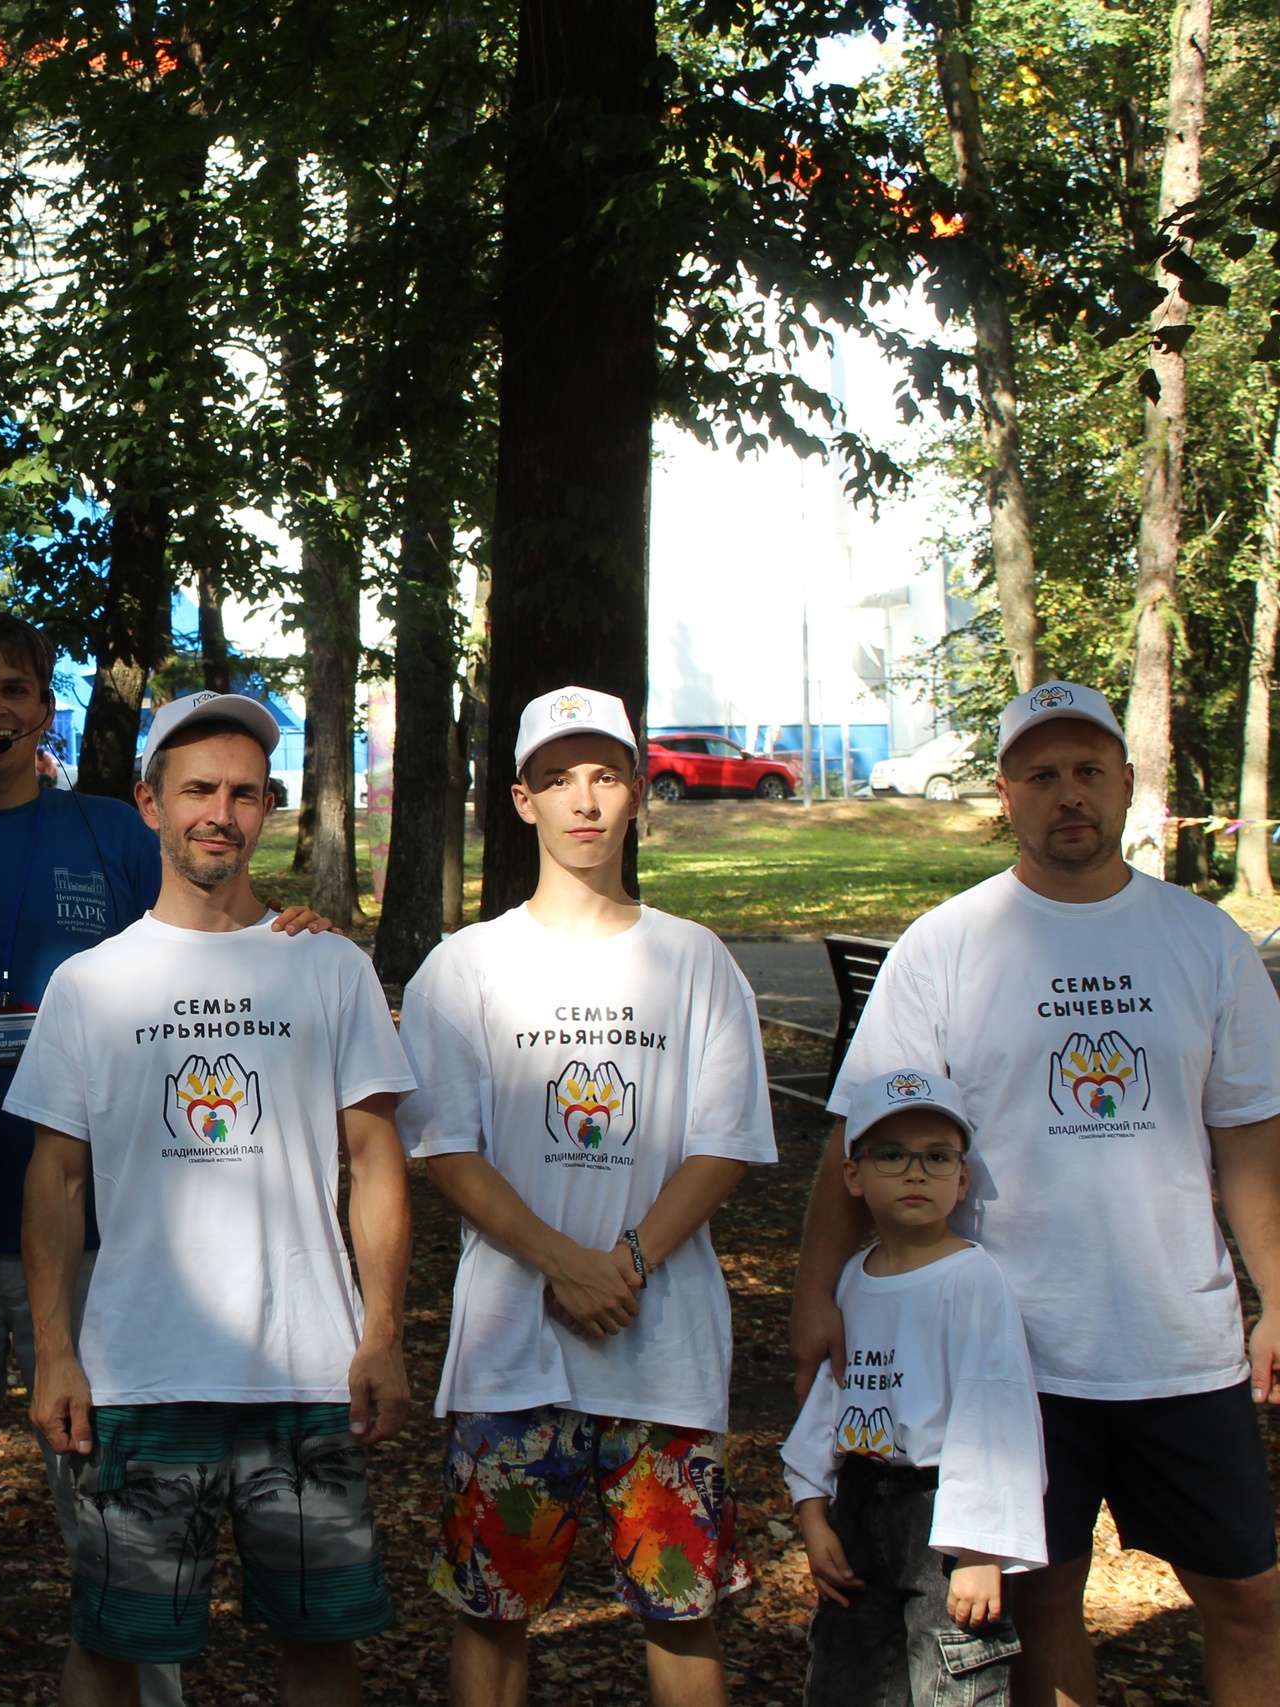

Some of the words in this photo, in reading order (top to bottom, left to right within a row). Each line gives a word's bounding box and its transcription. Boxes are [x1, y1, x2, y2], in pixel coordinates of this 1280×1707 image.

[56, 893, 106, 907] Центральный
[56, 902, 106, 923] ПАРК
[1051, 975, 1132, 993] СЕМЬЯ
[173, 998, 251, 1016] СЕМЬЯ
[555, 1006, 633, 1022] СЕМЬЯ
[1037, 997, 1153, 1018] СЫЧЕВЫХ
[135, 1020, 291, 1044] ГУРЬЯНОВЫХ
[516, 1029, 666, 1051] ГУРЬЯНОВЫХ
[1048, 1120, 1130, 1136] ВЛАДИМИРСКИЙ
[1133, 1121, 1156, 1131] ПАПА
[162, 1145, 239, 1158] ВЛАДИМИРСКИЙ
[241, 1145, 264, 1155] ПАПА
[848, 1349, 895, 1367] ЕМЬЯ
[690, 1468, 708, 1499] NIKE
